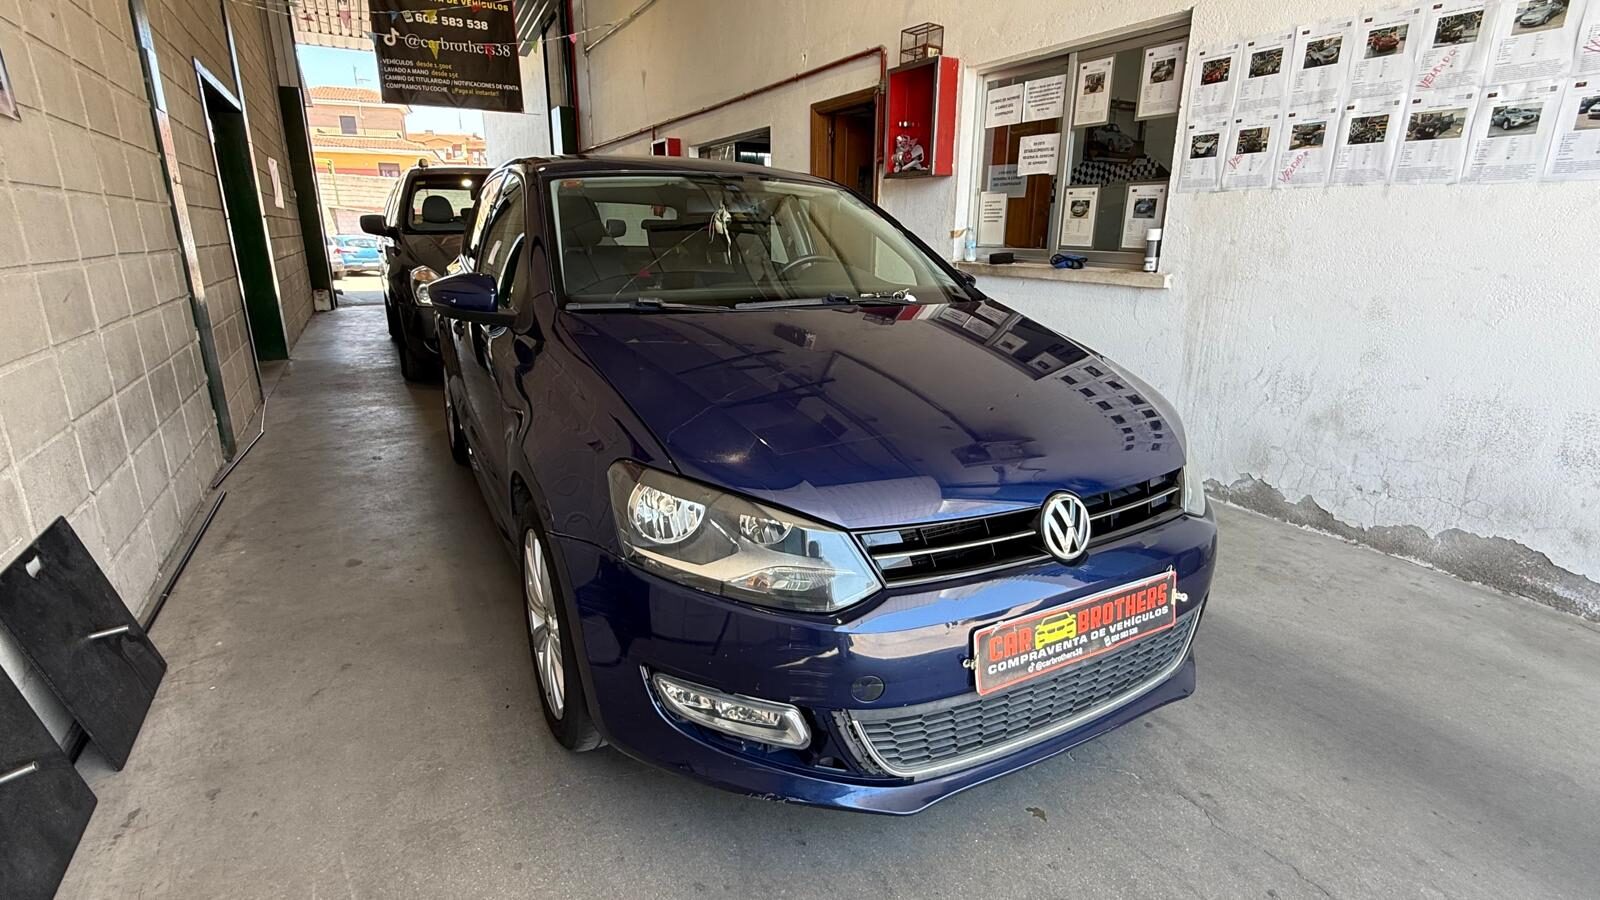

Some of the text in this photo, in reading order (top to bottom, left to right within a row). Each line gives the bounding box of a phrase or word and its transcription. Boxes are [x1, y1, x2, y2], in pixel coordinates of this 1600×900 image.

[415, 13, 489, 31] 602 583 538
[415, 60, 433, 68] desde
[384, 74, 407, 82] CAMBIO
[415, 76, 451, 85] TITULARIDAD
[453, 79, 495, 89] NOTIFICACIONES
[386, 82, 422, 91] COMPRAMOS
[988, 582, 1168, 661] CAR BROTHERS
[988, 605, 1169, 675] COMPRAVENTA DE VEHÍCULOS
